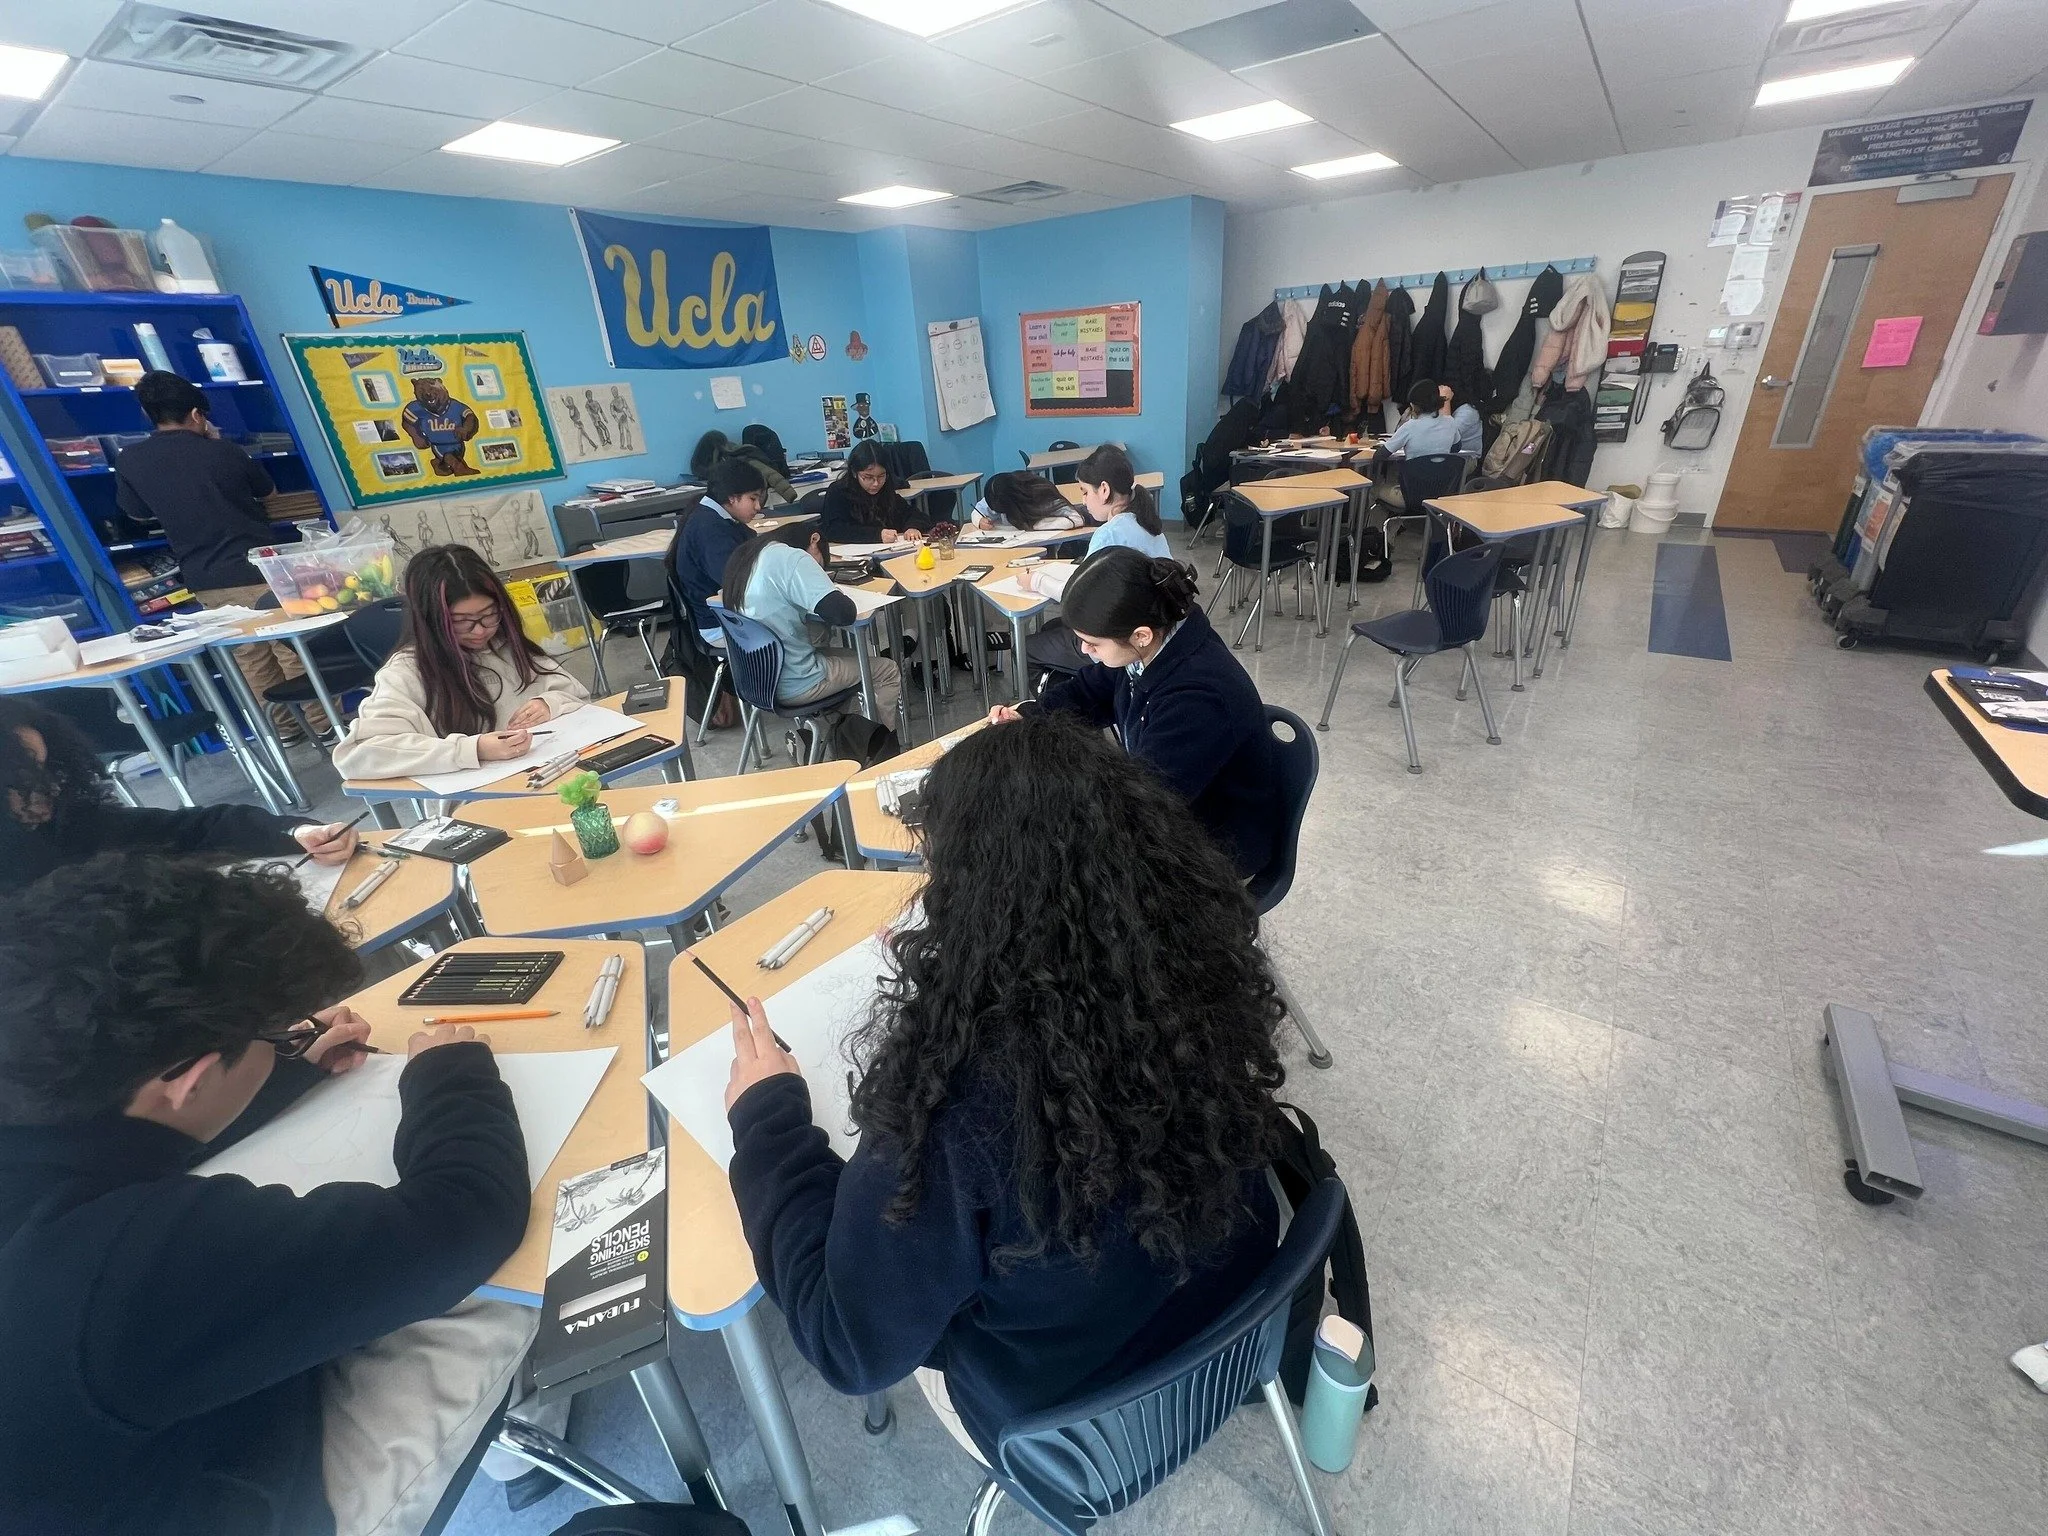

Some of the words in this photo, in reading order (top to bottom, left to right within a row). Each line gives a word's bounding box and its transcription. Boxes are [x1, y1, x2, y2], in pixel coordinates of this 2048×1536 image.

[1862, 133, 1883, 142] WITH
[1885, 130, 1902, 138] THE
[1850, 154, 1868, 162] AND
[1869, 148, 1912, 159] STRENGTH
[1913, 146, 1926, 154] OF
[1927, 139, 1978, 152] CHARACTER
[1962, 148, 1982, 157] AND
[325, 278, 403, 314] Ucla
[406, 292, 442, 306] Bruins
[604, 244, 776, 349] Ucla
[1328, 300, 1346, 308] adidas
[427, 418, 456, 432] Ucla
[591, 1219, 650, 1253] PENCILS
[590, 1234, 650, 1266] SKETCHING
[564, 1297, 640, 1335] FUBAINA
